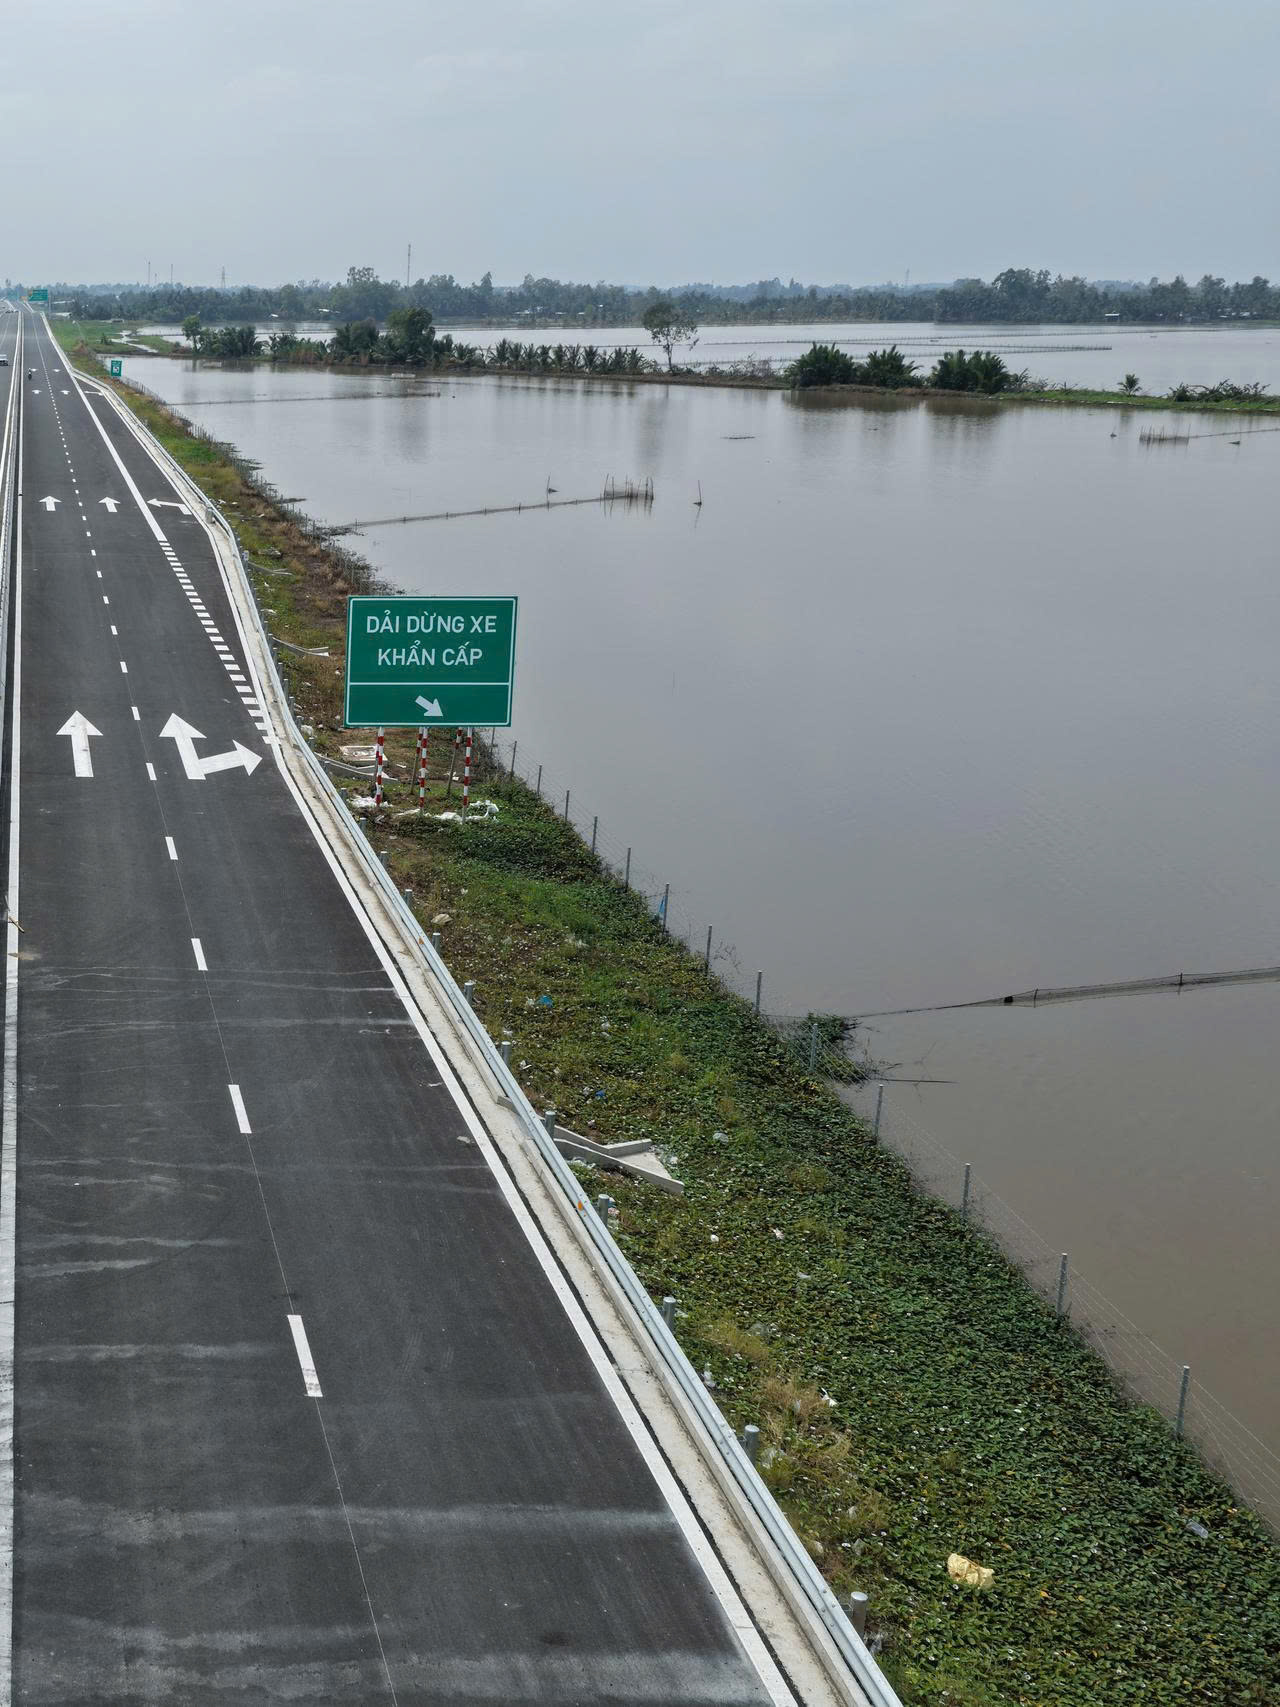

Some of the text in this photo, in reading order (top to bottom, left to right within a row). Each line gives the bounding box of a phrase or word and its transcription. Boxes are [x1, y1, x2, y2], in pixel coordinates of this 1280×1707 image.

[366, 609, 497, 633] DẢI DỪNG XE
[378, 640, 483, 666] KHẨN CẤP
